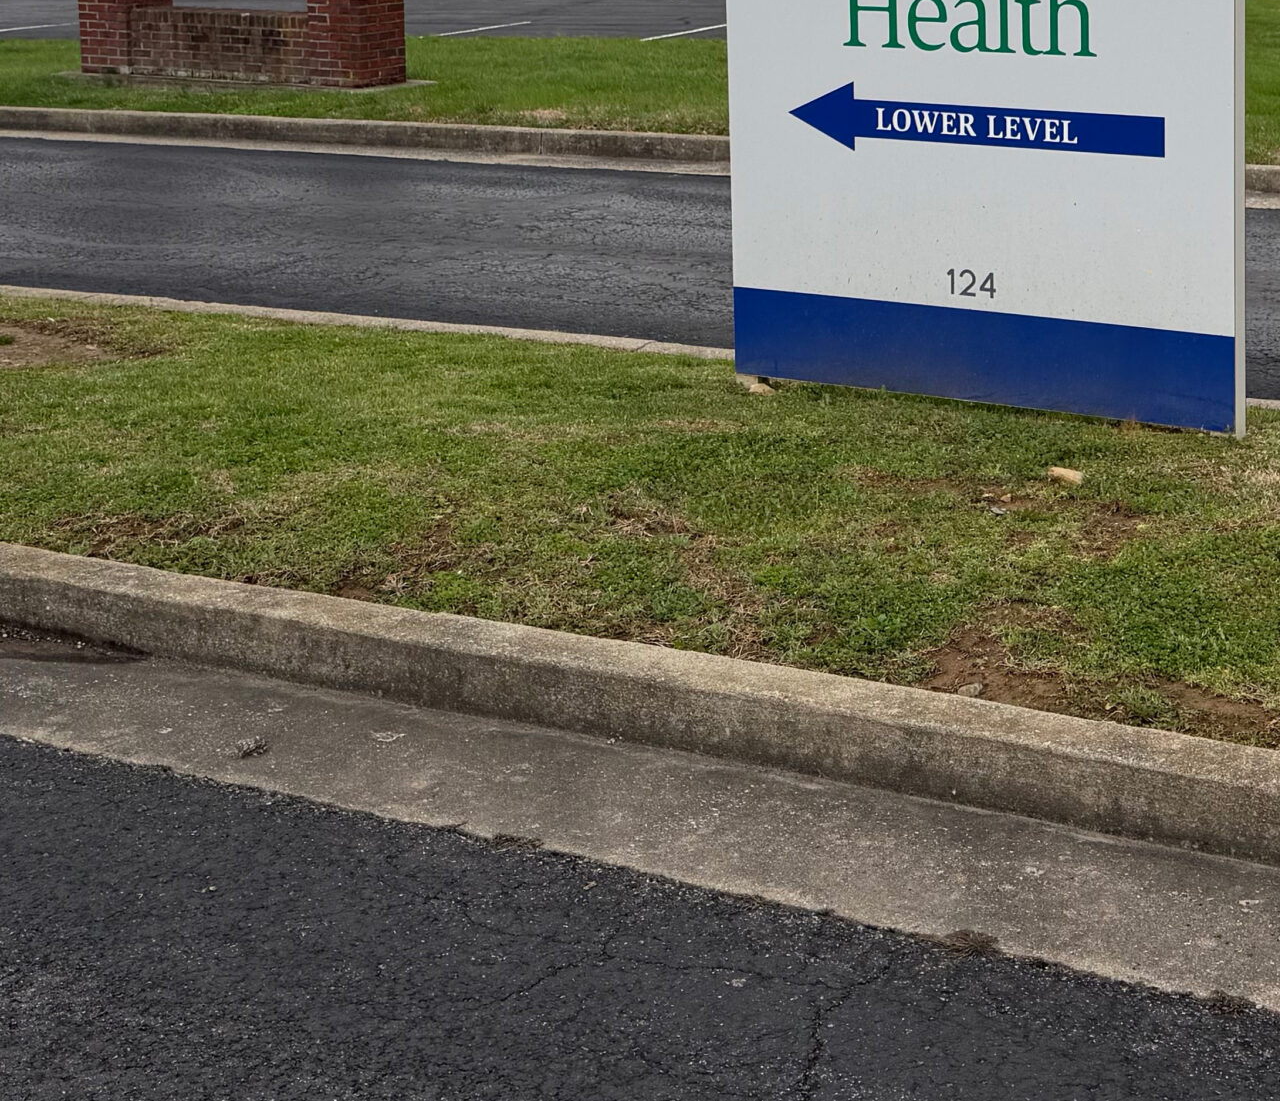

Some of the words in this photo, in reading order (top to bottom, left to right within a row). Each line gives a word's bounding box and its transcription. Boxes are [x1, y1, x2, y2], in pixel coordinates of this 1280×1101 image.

[876, 107, 977, 137] LOWER
[987, 115, 1078, 144] LEVEL
[946, 268, 997, 299] 124
